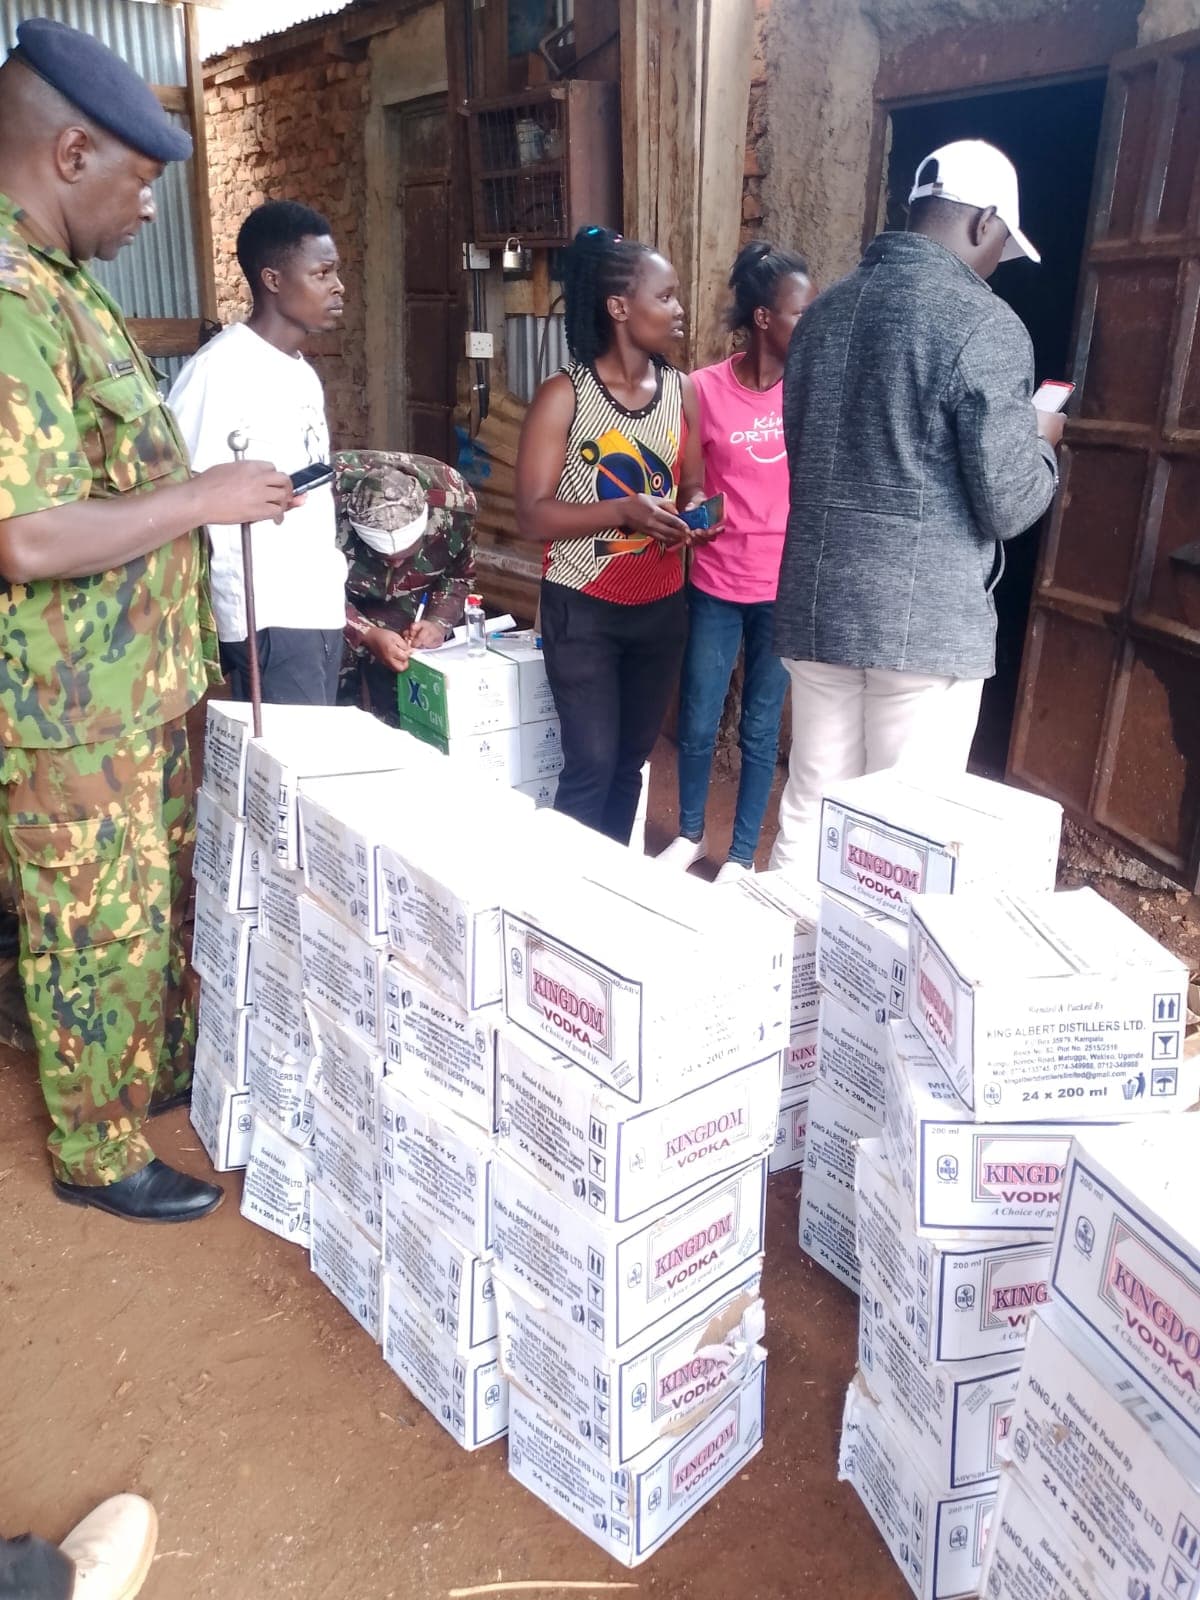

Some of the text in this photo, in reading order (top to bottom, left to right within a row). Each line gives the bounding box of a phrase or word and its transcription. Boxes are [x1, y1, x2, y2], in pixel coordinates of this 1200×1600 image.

[847, 843, 920, 892] KINGDOM
[856, 872, 903, 903] VODKA
[858, 886, 876, 900] Choice
[533, 968, 604, 1035] KINGDOM
[543, 1006, 592, 1048] VODKA
[545, 1024, 564, 1041] Choice
[565, 1038, 571, 1049] of
[587, 1050, 600, 1066] Life
[986, 1020, 1146, 1039] KING ALBERT DISTILLERS LTD.
[834, 1036, 855, 1053] ALBERT
[855, 1049, 886, 1074] DISTILLERS
[1118, 1052, 1144, 1061] Uganda
[515, 1082, 536, 1103] ALBERT
[537, 1099, 571, 1131] DISTILLERS
[572, 1125, 585, 1142] LTD.
[834, 1079, 876, 1112] 24 200 ml
[1022, 1086, 1108, 1101] 24 x 200 ml
[665, 1108, 743, 1160] KINGDOM
[677, 1138, 731, 1168] VODKA
[811, 1121, 848, 1146] KING ALBERT
[520, 1139, 565, 1182] 24 200 ml
[827, 1170, 837, 1180] 24
[1001, 1191, 1061, 1204] VODK
[1079, 1174, 1104, 1200] 200 ml
[494, 1198, 508, 1215] KING
[507, 1211, 532, 1230] ALBERT
[533, 1227, 569, 1260] DISTILLERS
[806, 1200, 840, 1227] KING ALBERT
[1001, 1207, 1032, 1216] Choice
[1034, 1208, 1045, 1217] of
[655, 1212, 734, 1280] KINGDOM
[819, 1249, 860, 1285] 24 200 ml
[513, 1264, 563, 1307] 24 200 ml
[667, 1249, 718, 1289] VODKA
[994, 1283, 1048, 1310] KING
[1113, 1260, 1200, 1361] KINGDO
[519, 1323, 542, 1345] ALBERT
[542, 1342, 576, 1376] DISTILLERS
[1111, 1323, 1120, 1333] A
[1120, 1329, 1150, 1364] Choice
[1150, 1359, 1162, 1375] of
[1160, 1374, 1187, 1400] good
[1124, 1307, 1197, 1390] VODKA
[671, 1371, 727, 1409] VODKA
[514, 1408, 592, 1473] KING ALBERT DISTILLERS
[1066, 1391, 1092, 1425] Blended
[1098, 1427, 1122, 1460] Packed
[1122, 1456, 1133, 1472] By
[675, 1419, 735, 1489] KINGDOM
[684, 1452, 725, 1493] VODKA
[1028, 1376, 1165, 1542] KING ALBERT DISTILLERS LTD.
[533, 1469, 584, 1514] 24 200 ml
[1042, 1474, 1058, 1497] 24
[1071, 1511, 1095, 1544] 200
[1098, 1546, 1116, 1570] ml
[1001, 1518, 1023, 1548] KING
[1022, 1545, 1060, 1591] ALBERT
